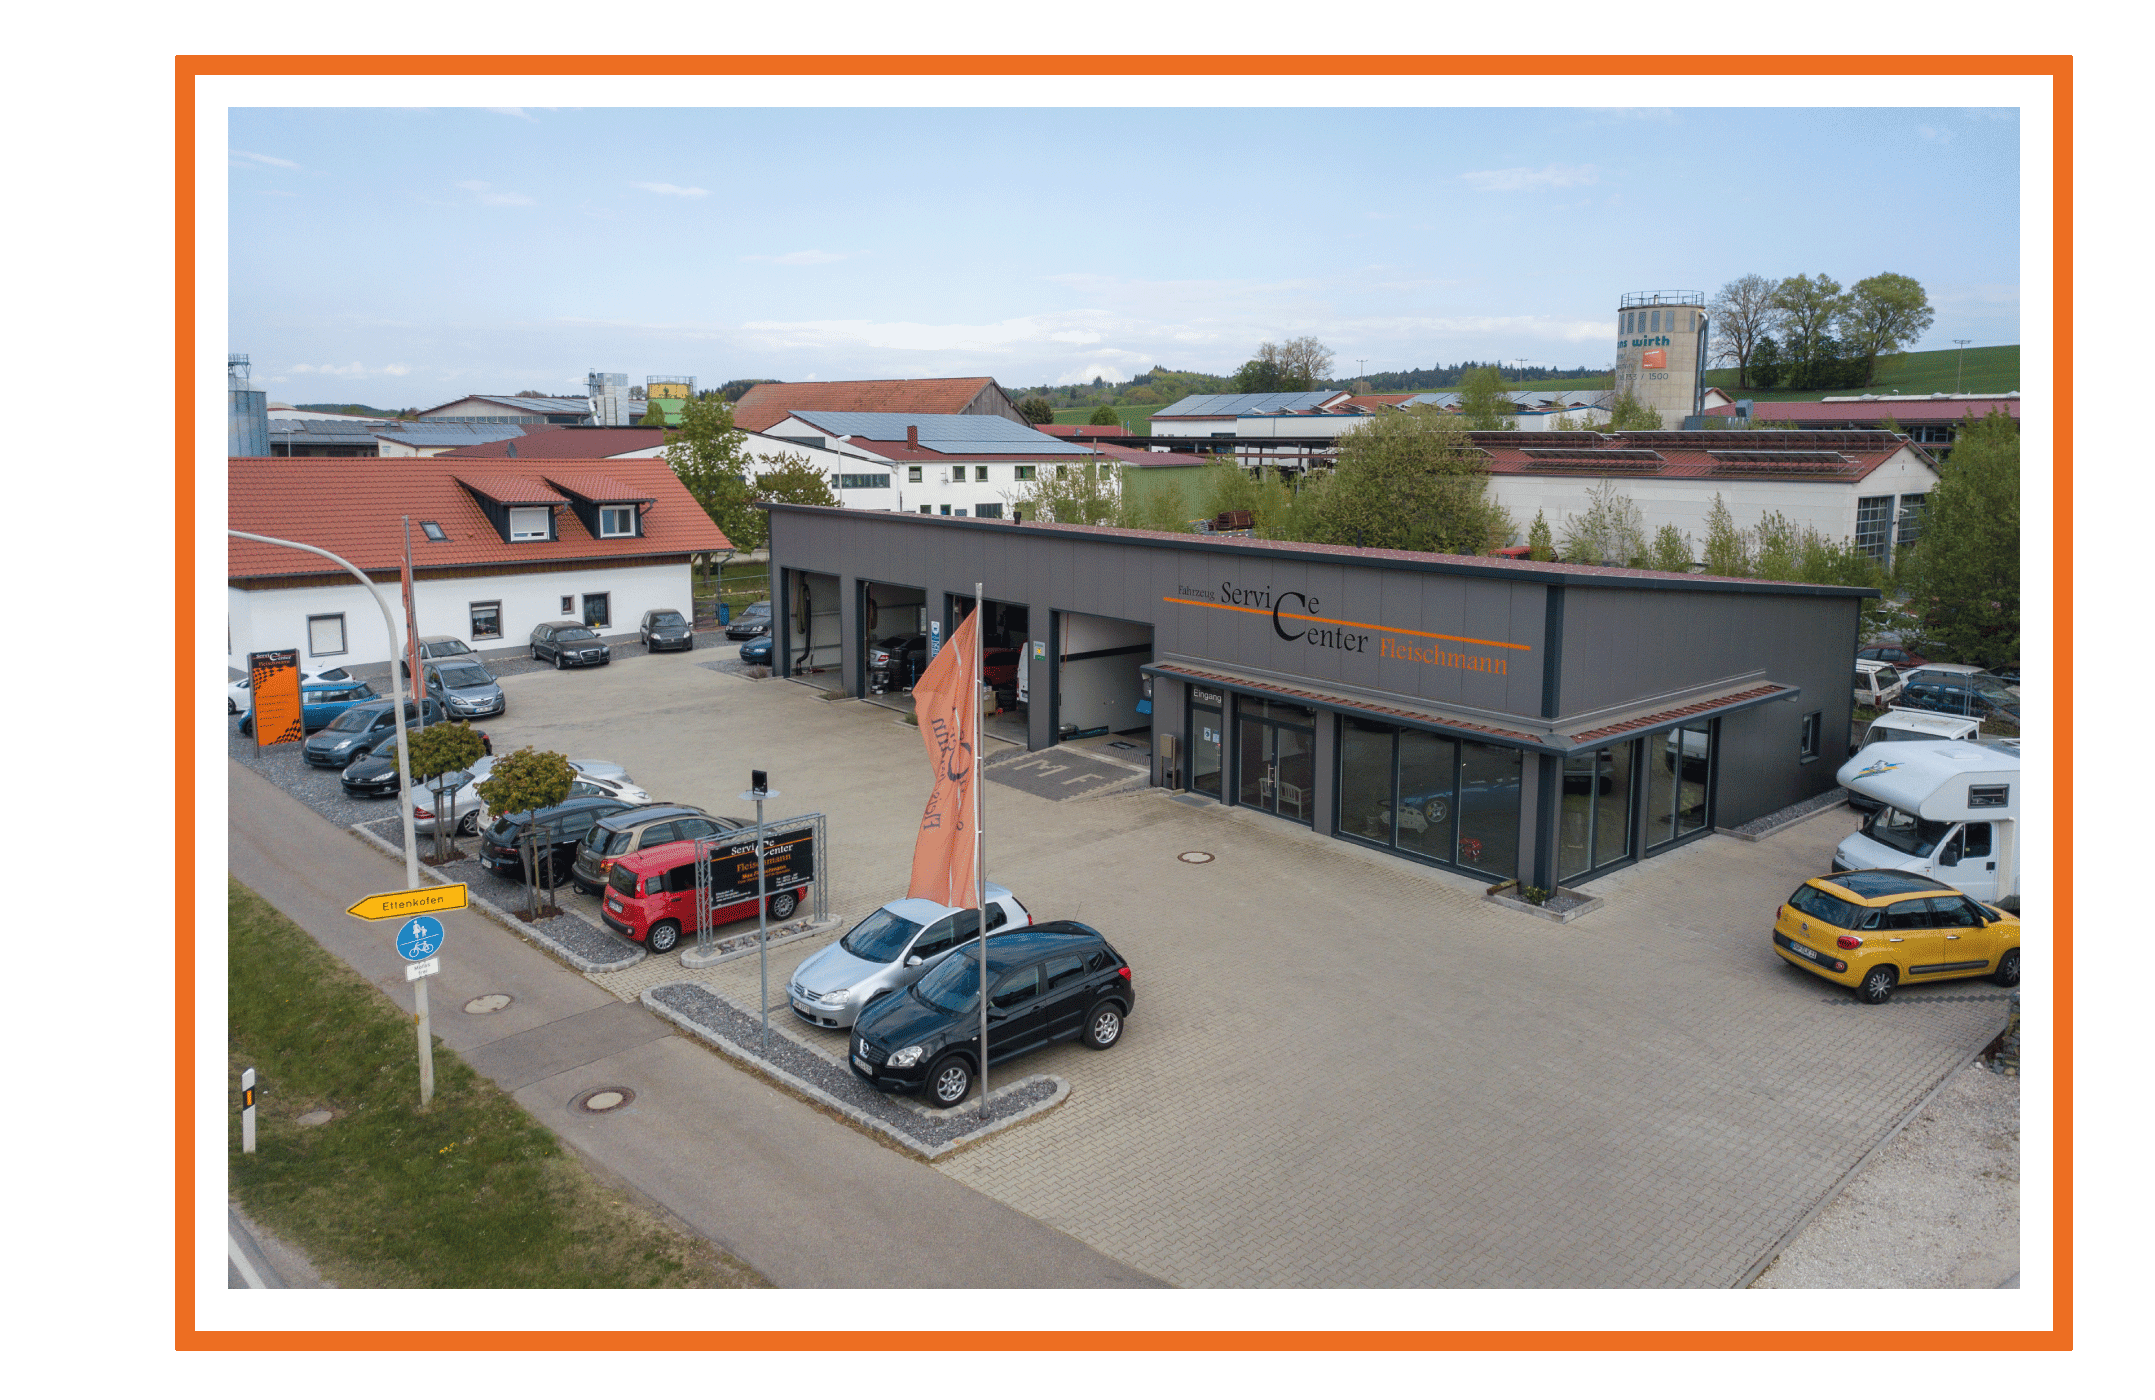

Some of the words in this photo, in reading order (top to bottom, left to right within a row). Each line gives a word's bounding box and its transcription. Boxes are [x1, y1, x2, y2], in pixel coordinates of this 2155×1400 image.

[1632, 334, 1670, 347] wirth
[1649, 372, 1669, 380] 1500
[1178, 585, 1215, 600] Fahrzeug
[1380, 637, 1507, 675] Fleischmann
[1193, 688, 1222, 704] Eingang
[736, 853, 792, 873] Fleismann
[382, 896, 444, 911] Ettenkofen
